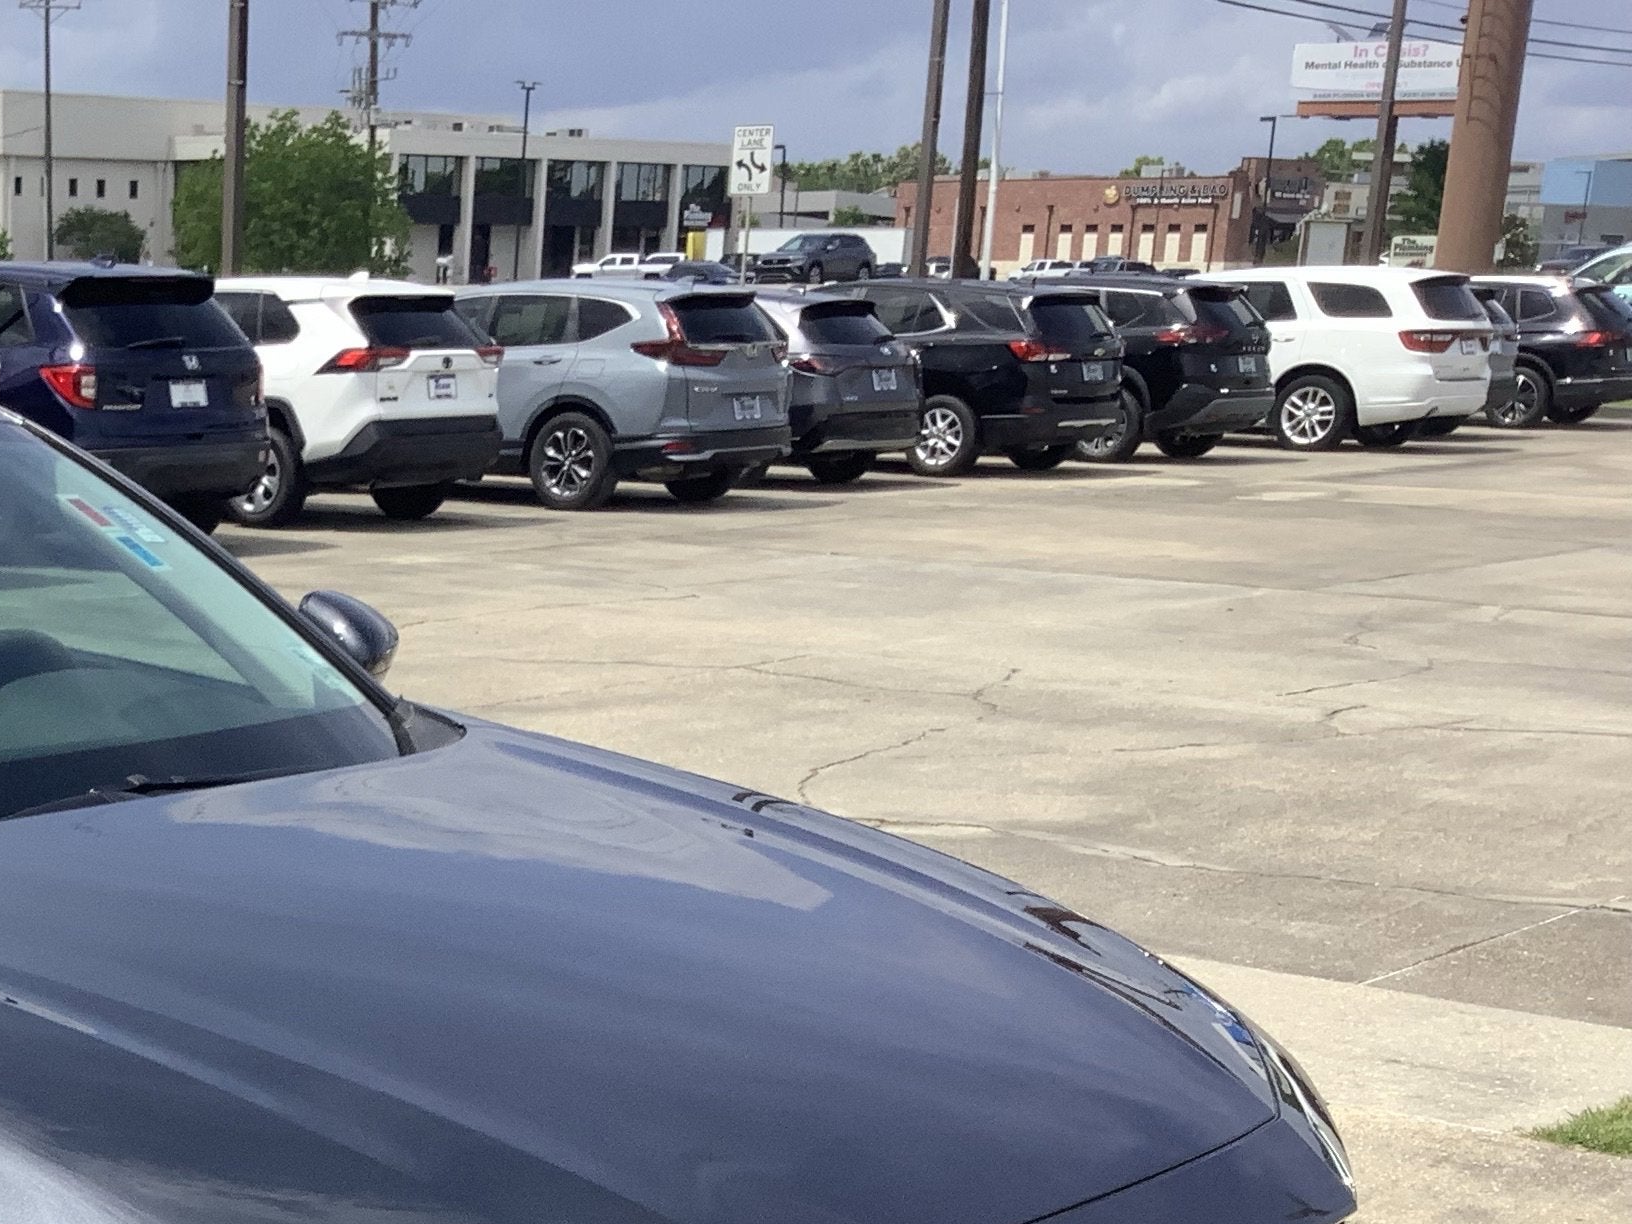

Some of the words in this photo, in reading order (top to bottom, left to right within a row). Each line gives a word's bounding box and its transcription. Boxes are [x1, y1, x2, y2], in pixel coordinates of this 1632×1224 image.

[1353, 45, 1368, 58] In
[1374, 44, 1430, 58] Csis?
[1304, 61, 1342, 70] Mental
[1344, 60, 1379, 70] Health
[1397, 59, 1453, 69] Substance
[736, 128, 771, 138] CENTER
[741, 138, 765, 147] LANE
[737, 183, 761, 192] ONLY
[1190, 184, 1198, 196] &
[1202, 184, 1230, 196] BAO
